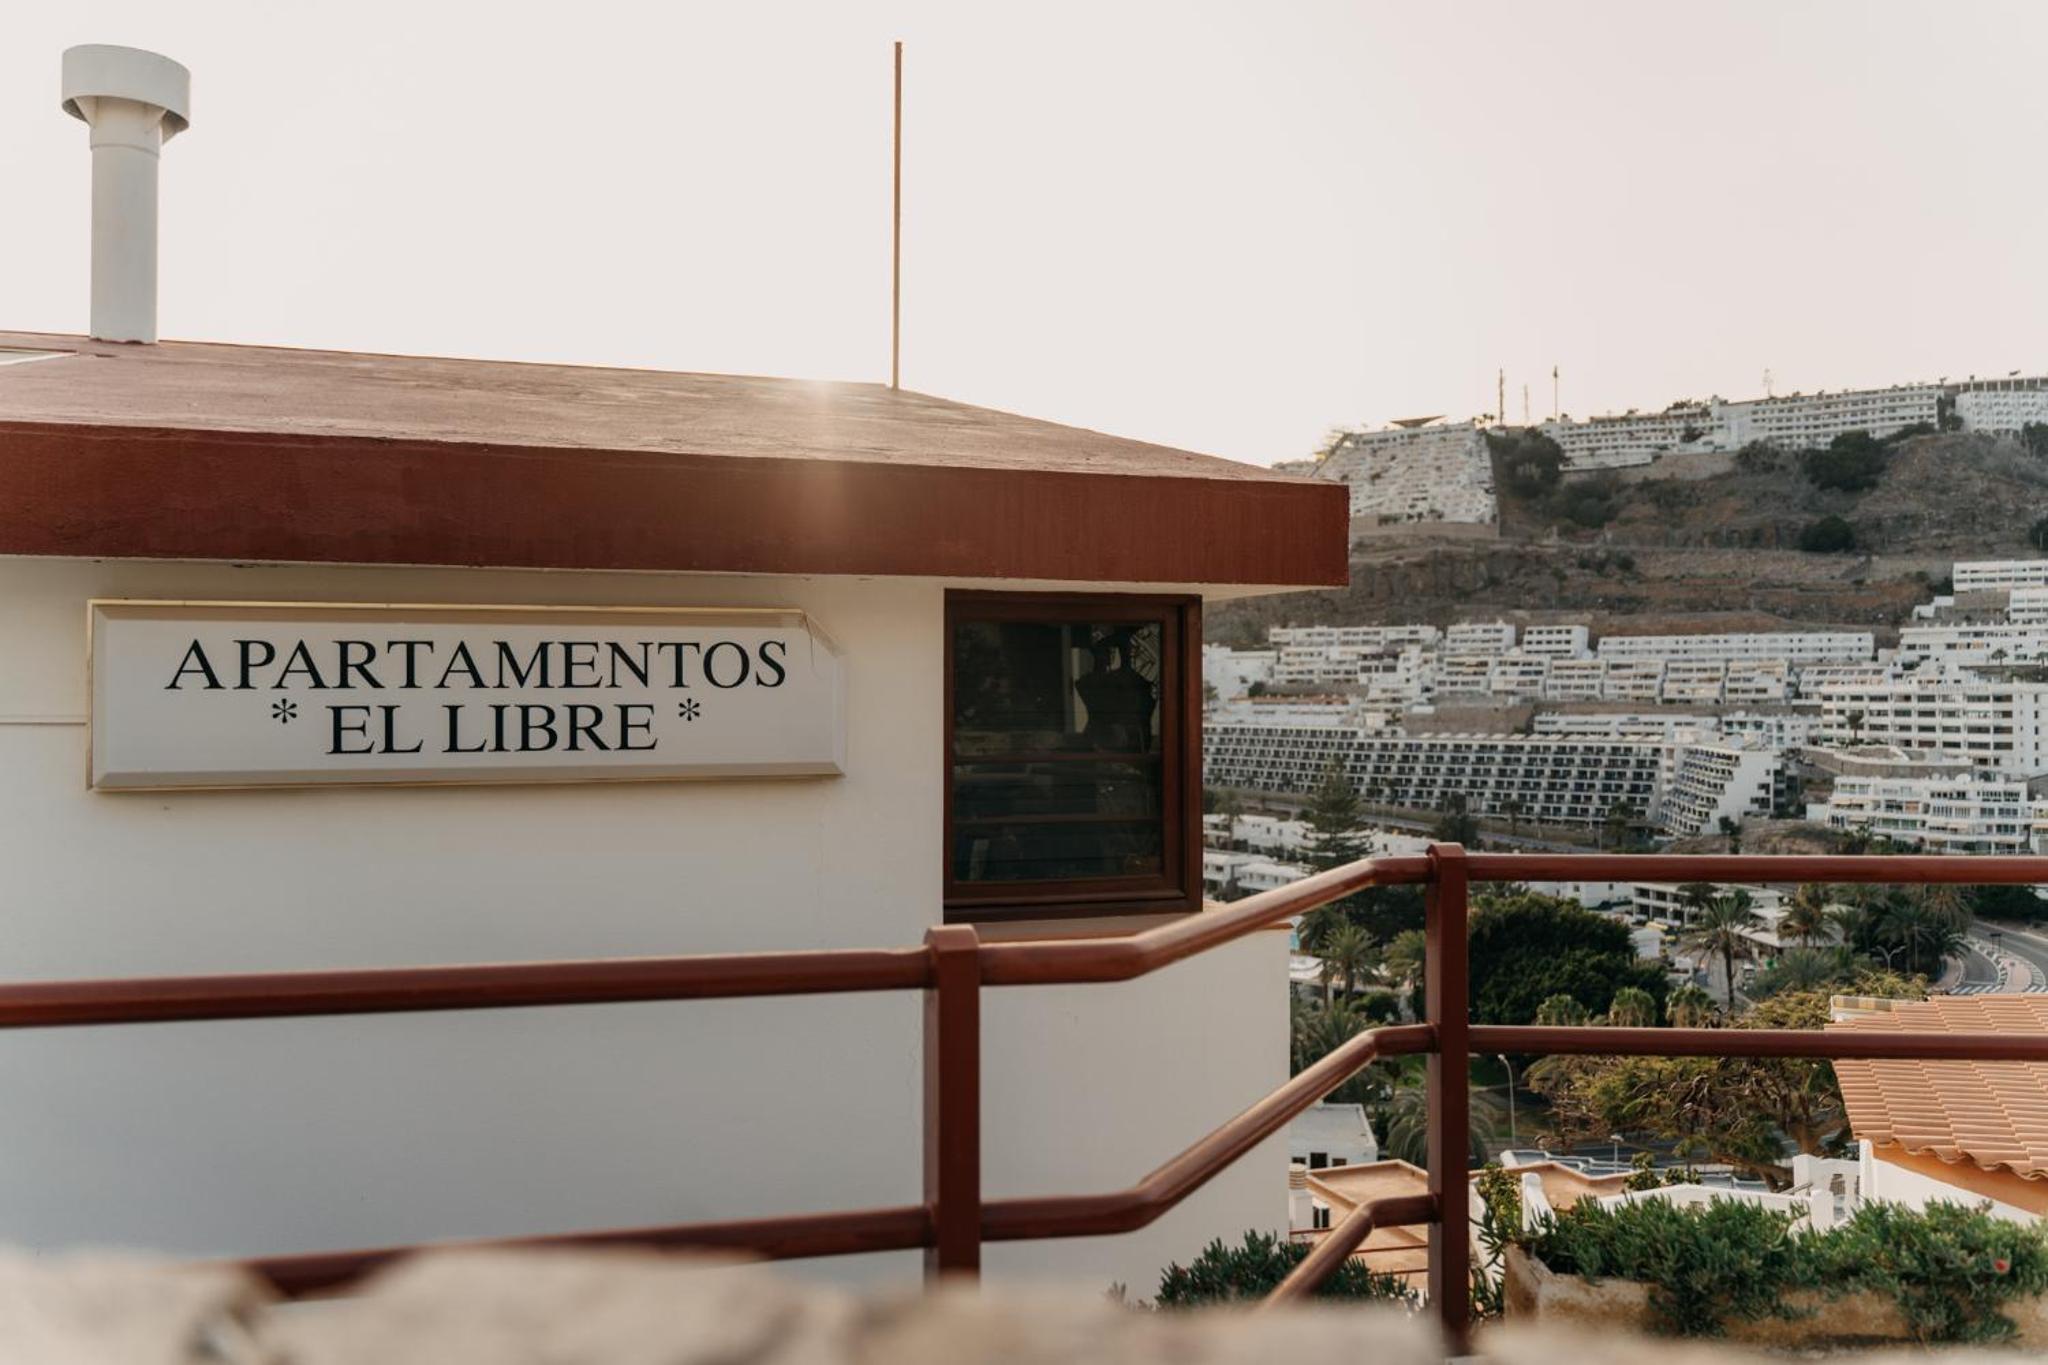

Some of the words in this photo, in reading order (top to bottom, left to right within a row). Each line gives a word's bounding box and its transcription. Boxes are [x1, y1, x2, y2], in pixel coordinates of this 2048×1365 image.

[164, 638, 787, 691] APARTAMENTOS
[325, 704, 424, 756] EL
[441, 703, 658, 754] LIBRE
